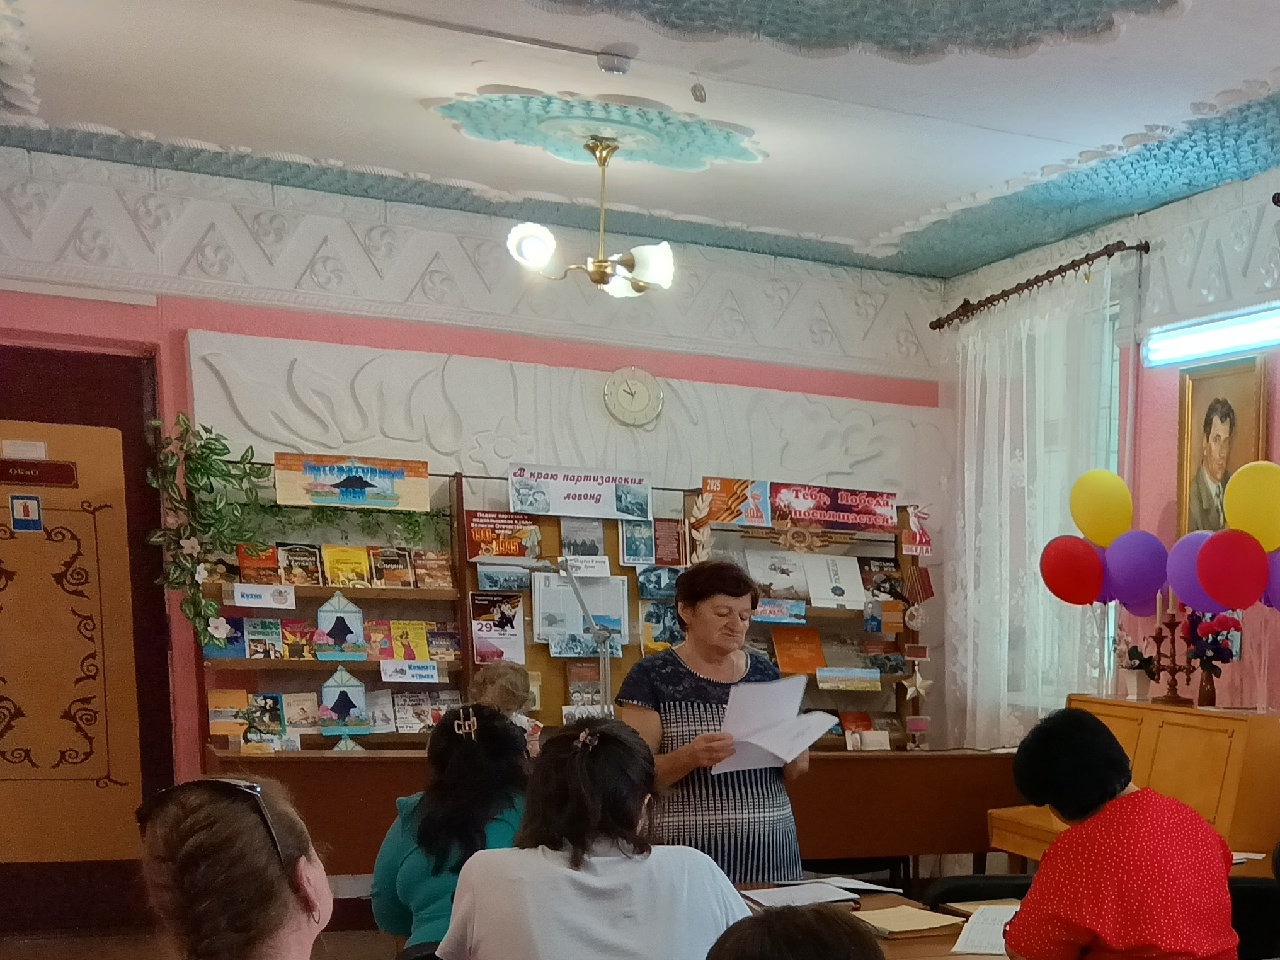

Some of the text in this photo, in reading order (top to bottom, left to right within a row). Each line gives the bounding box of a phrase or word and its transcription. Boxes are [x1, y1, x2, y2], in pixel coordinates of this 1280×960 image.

[513, 467, 644, 486] В краю партизанских
[791, 487, 895, 511] Тебе, Победа,
[477, 622, 492, 632] 29
